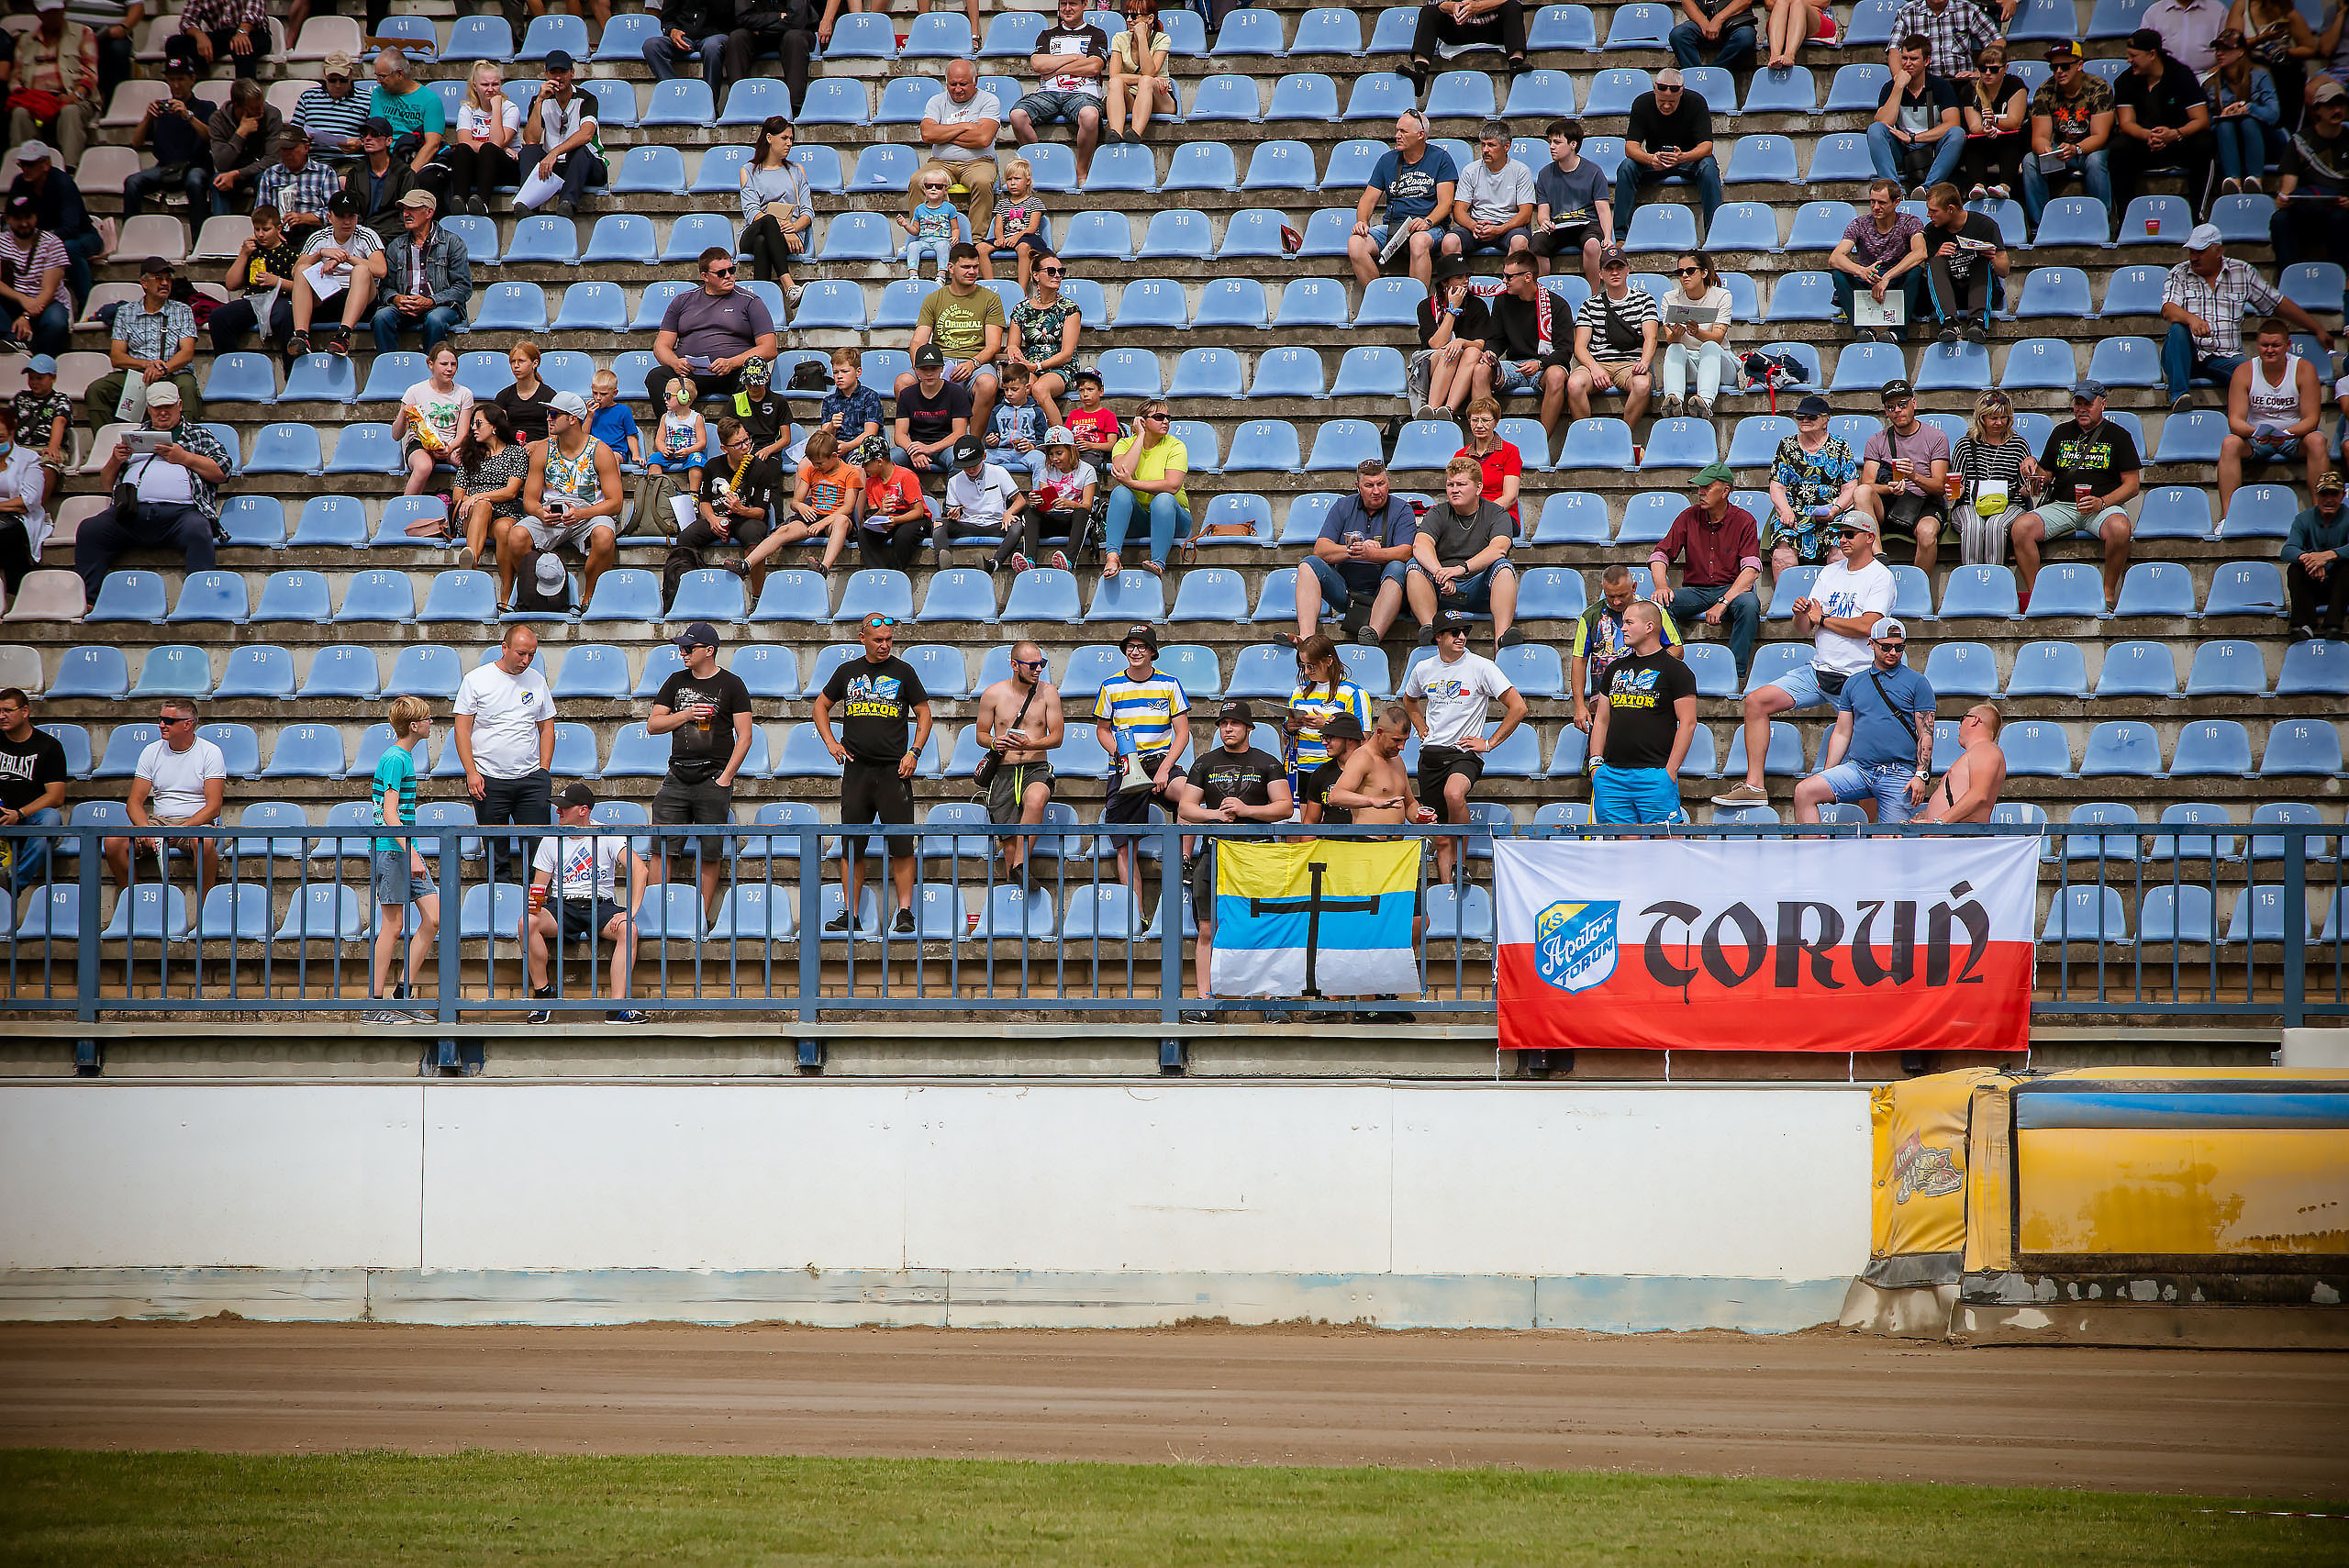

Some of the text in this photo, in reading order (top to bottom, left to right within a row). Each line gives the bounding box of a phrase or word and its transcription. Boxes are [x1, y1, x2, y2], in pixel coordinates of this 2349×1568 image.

[1635, 6, 1649, 18] 25
[1166, 15, 1179, 28] 31
[1241, 14, 1258, 26] 30
[1859, 66, 1872, 79] 22
[1219, 78, 1233, 91] 30
[1297, 78, 1312, 91] 29
[1374, 80, 1389, 91] 28
[1535, 75, 1549, 86] 26
[674, 85, 688, 96] 37
[829, 83, 841, 95] 35
[907, 82, 920, 93] 34
[1353, 145, 1369, 156] 28
[1513, 142, 1527, 154] 26
[1595, 142, 1609, 154] 25
[1757, 139, 1771, 150] 23
[1838, 139, 1854, 150] 22
[642, 149, 657, 161] 37
[725, 149, 739, 161] 36
[800, 150, 814, 162] 35
[880, 150, 895, 161] 34
[1034, 147, 1049, 160] 32
[1112, 146, 1128, 159] 31
[1196, 146, 1210, 158] 30
[1272, 147, 1287, 159] 29
[1249, 211, 1263, 224] 29
[1658, 208, 1673, 220] 24
[1739, 206, 1754, 218] 23
[1819, 206, 1831, 218] 22
[540, 217, 554, 230] 38
[618, 219, 630, 230] 37
[690, 216, 705, 228] 36
[853, 216, 866, 228] 34
[1095, 216, 1105, 228] 31
[1175, 214, 1189, 226] 30
[1800, 274, 1816, 286] 22
[2045, 272, 2061, 284] 19
[2131, 271, 2145, 283] 18
[505, 284, 520, 297] 38
[586, 284, 601, 296] 37
[662, 285, 676, 297] 36
[824, 284, 838, 295] 34
[905, 281, 918, 294] 33
[1143, 283, 1161, 295] 30
[1226, 280, 1241, 293] 29
[1304, 284, 1319, 295] 28
[1386, 281, 1402, 293] 27
[937, 306, 951, 336] CLOTHING
[1863, 347, 1874, 358] 21
[2032, 344, 2044, 355] 19
[2118, 340, 2132, 353] 18
[394, 354, 410, 367] 39
[477, 353, 492, 366] 38
[554, 353, 569, 366] 37
[877, 352, 890, 365] 33
[1118, 351, 1132, 364] 30
[1200, 351, 1217, 363] 29
[1282, 350, 1298, 361] 28
[1364, 350, 1380, 361] 27
[231, 357, 243, 368] 41
[2252, 395, 2296, 406] LEE COOPER
[762, 402, 774, 415] 5
[1588, 420, 1603, 432] 24
[1672, 420, 1687, 432] 23
[1760, 418, 1776, 431] 22
[1843, 419, 1858, 431] 21
[2190, 414, 2203, 426] 17
[278, 426, 293, 439] 40
[362, 427, 377, 439] 39
[1256, 423, 1271, 436] 28
[1337, 423, 1356, 435] 27
[2062, 450, 2104, 462] Unkown
[240, 498, 256, 511] 40
[322, 499, 337, 512] 39
[405, 500, 419, 511] 38
[1566, 495, 1582, 508] 24
[1650, 495, 1664, 507] 23
[372, 572, 385, 584] 38
[700, 571, 715, 584] 34
[785, 572, 802, 584] 33
[869, 573, 887, 585] 32
[952, 573, 964, 584] 31
[1208, 572, 1222, 584] 28
[1547, 573, 1560, 584] 24
[2062, 567, 2075, 580] 18
[2151, 567, 2163, 579] 17
[126, 575, 137, 587] 41
[206, 574, 220, 587] 40
[288, 575, 303, 587] 39
[454, 574, 469, 586] 37
[84, 651, 98, 662] 41
[168, 648, 183, 661] 40
[252, 650, 267, 662] 39
[336, 647, 352, 660] 38
[419, 648, 435, 661] 37
[754, 649, 768, 661] 33
[923, 650, 937, 662] 31
[1097, 651, 1114, 662] 29
[1262, 649, 1279, 661] 27
[1696, 646, 1711, 659] 22
[1782, 647, 1796, 659] 21
[1955, 647, 1967, 660] 19
[2044, 646, 2057, 659] 18
[2132, 647, 2145, 660] 17
[846, 702, 899, 717] APATOR
[217, 728, 231, 739] 39
[300, 727, 315, 740] 38
[2026, 726, 2040, 739] 18
[92, 806, 106, 818] 40
[264, 806, 277, 817] 38
[607, 808, 620, 819] 34
[2186, 810, 2199, 823] 16
[52, 891, 67, 904] 40
[747, 890, 762, 902] 32
[2076, 893, 2089, 906] 17
[1540, 912, 1564, 935] KS
[1542, 917, 1613, 975] Apator
